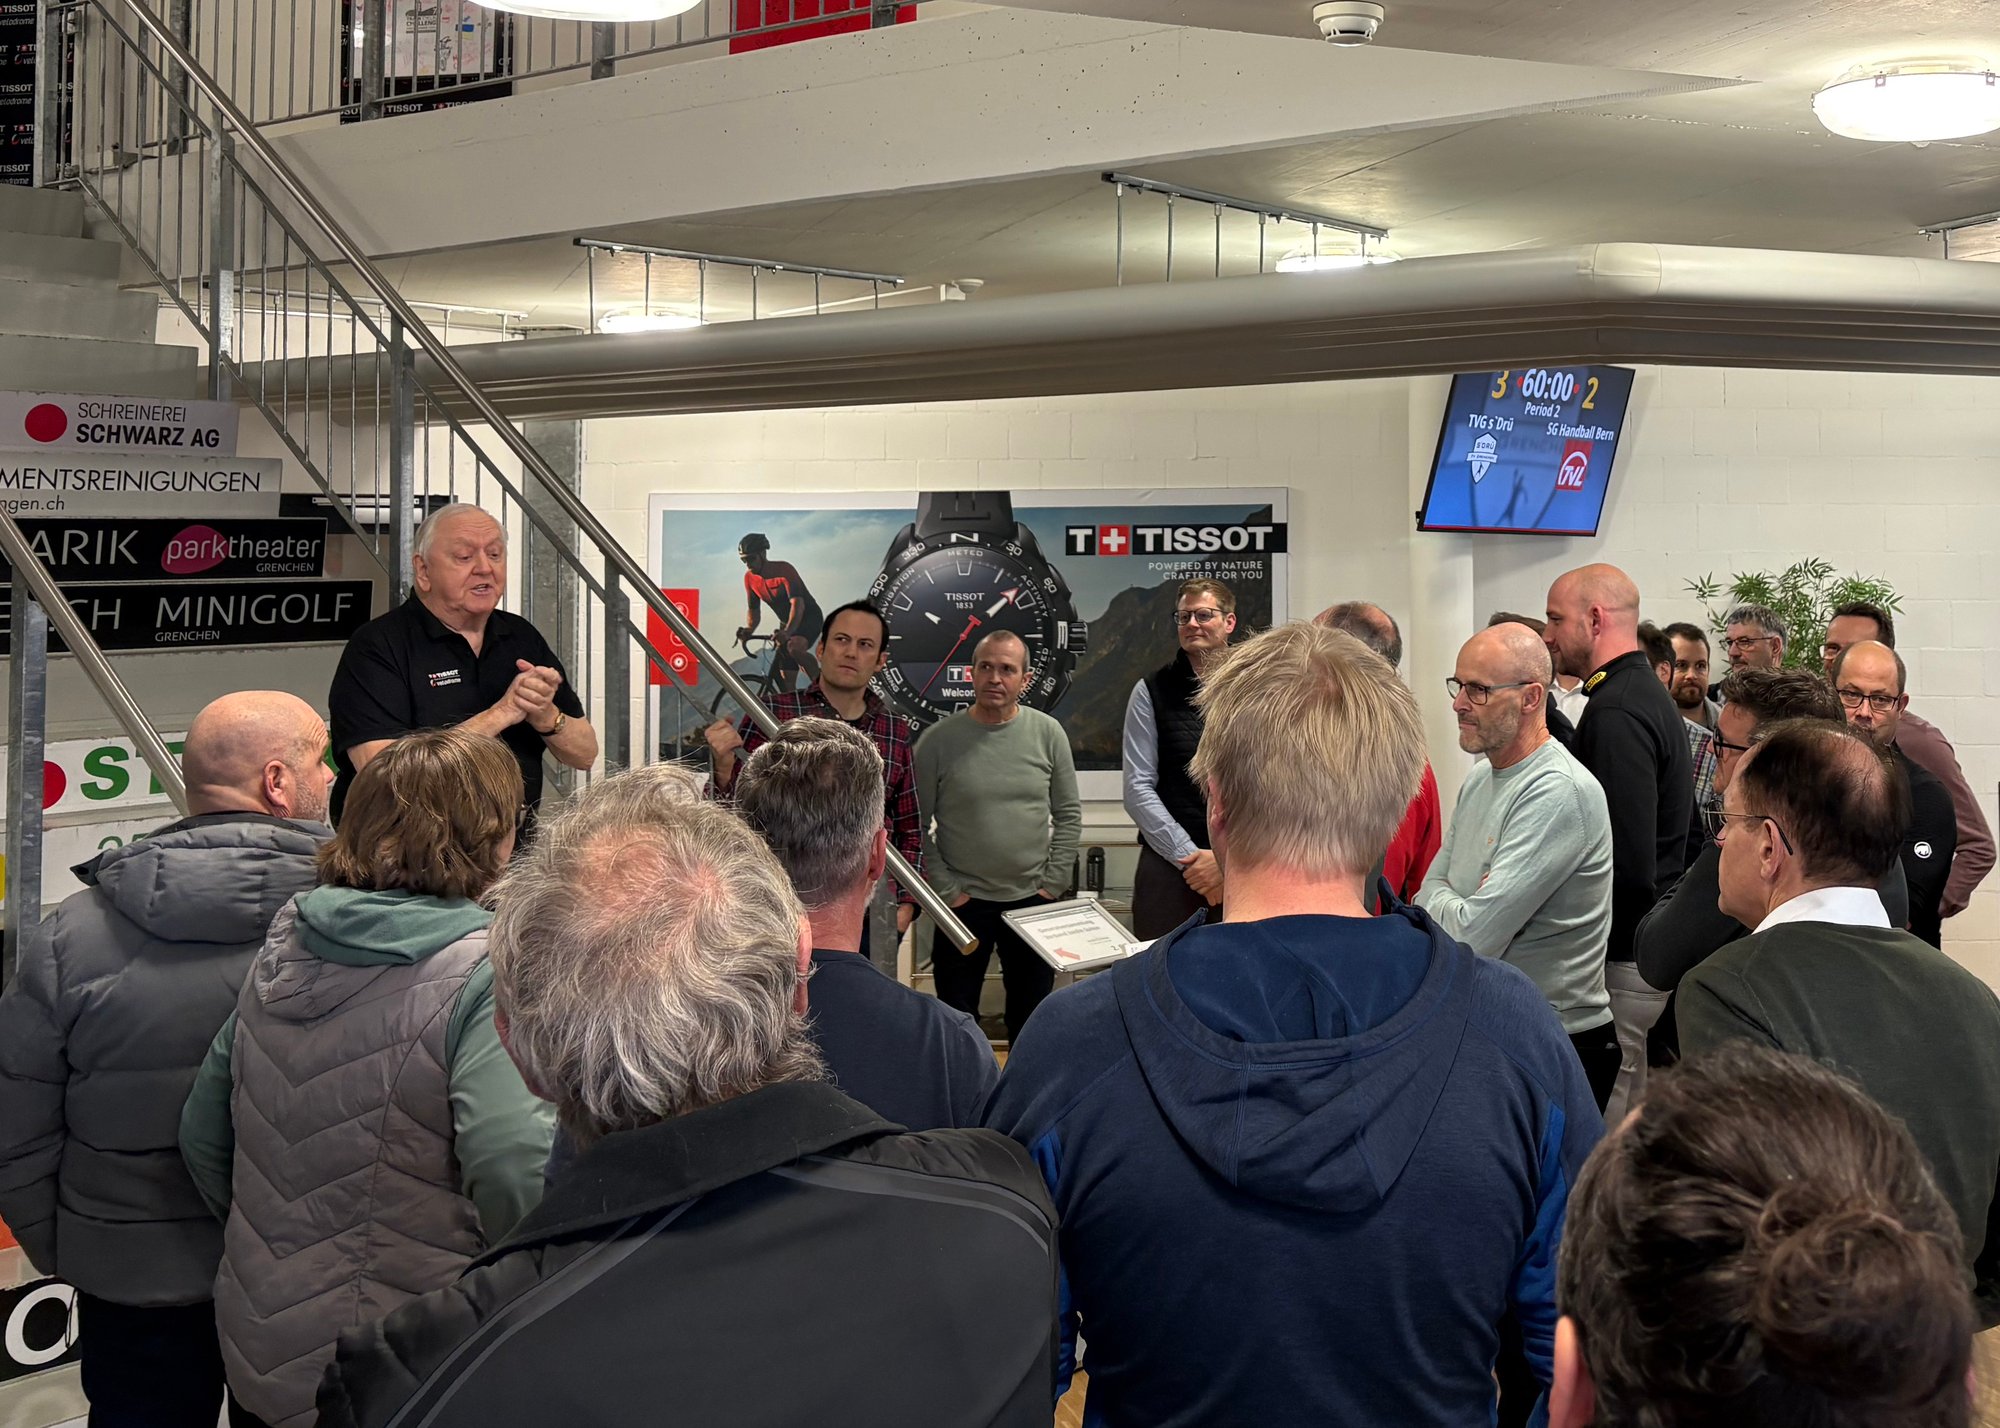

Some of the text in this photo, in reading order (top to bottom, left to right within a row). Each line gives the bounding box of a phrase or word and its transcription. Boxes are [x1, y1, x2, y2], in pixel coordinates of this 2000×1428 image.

[1, 83, 33, 93] TISSOT
[387, 103, 424, 113] TISSOT
[1491, 368, 1599, 410] 3 60:00 2
[77, 402, 187, 423] SCHREINEREI
[1524, 401, 1561, 418] Period 2
[1468, 414, 1487, 430] TVG
[75, 423, 220, 448] SCHWARZ AG
[1546, 422, 1615, 442] SG Handball Bern
[950, 532, 979, 543] N
[1068, 526, 1273, 553] T TISSOT
[166, 534, 321, 565] parktheater
[902, 542, 926, 561] 330
[1005, 542, 1023, 557] 30
[256, 562, 315, 573] GRENCHEN
[1148, 560, 1264, 571] POWERED BY NATURE
[1163, 570, 1264, 581] CRAFTED FOR YOU
[870, 573, 889, 597] 300
[944, 592, 985, 601] TISSOT
[1021, 574, 1049, 618] ACTIVITY
[155, 593, 354, 629] MINIGOLF
[955, 601, 974, 610] 1853
[154, 630, 221, 642] GRENCHEN
